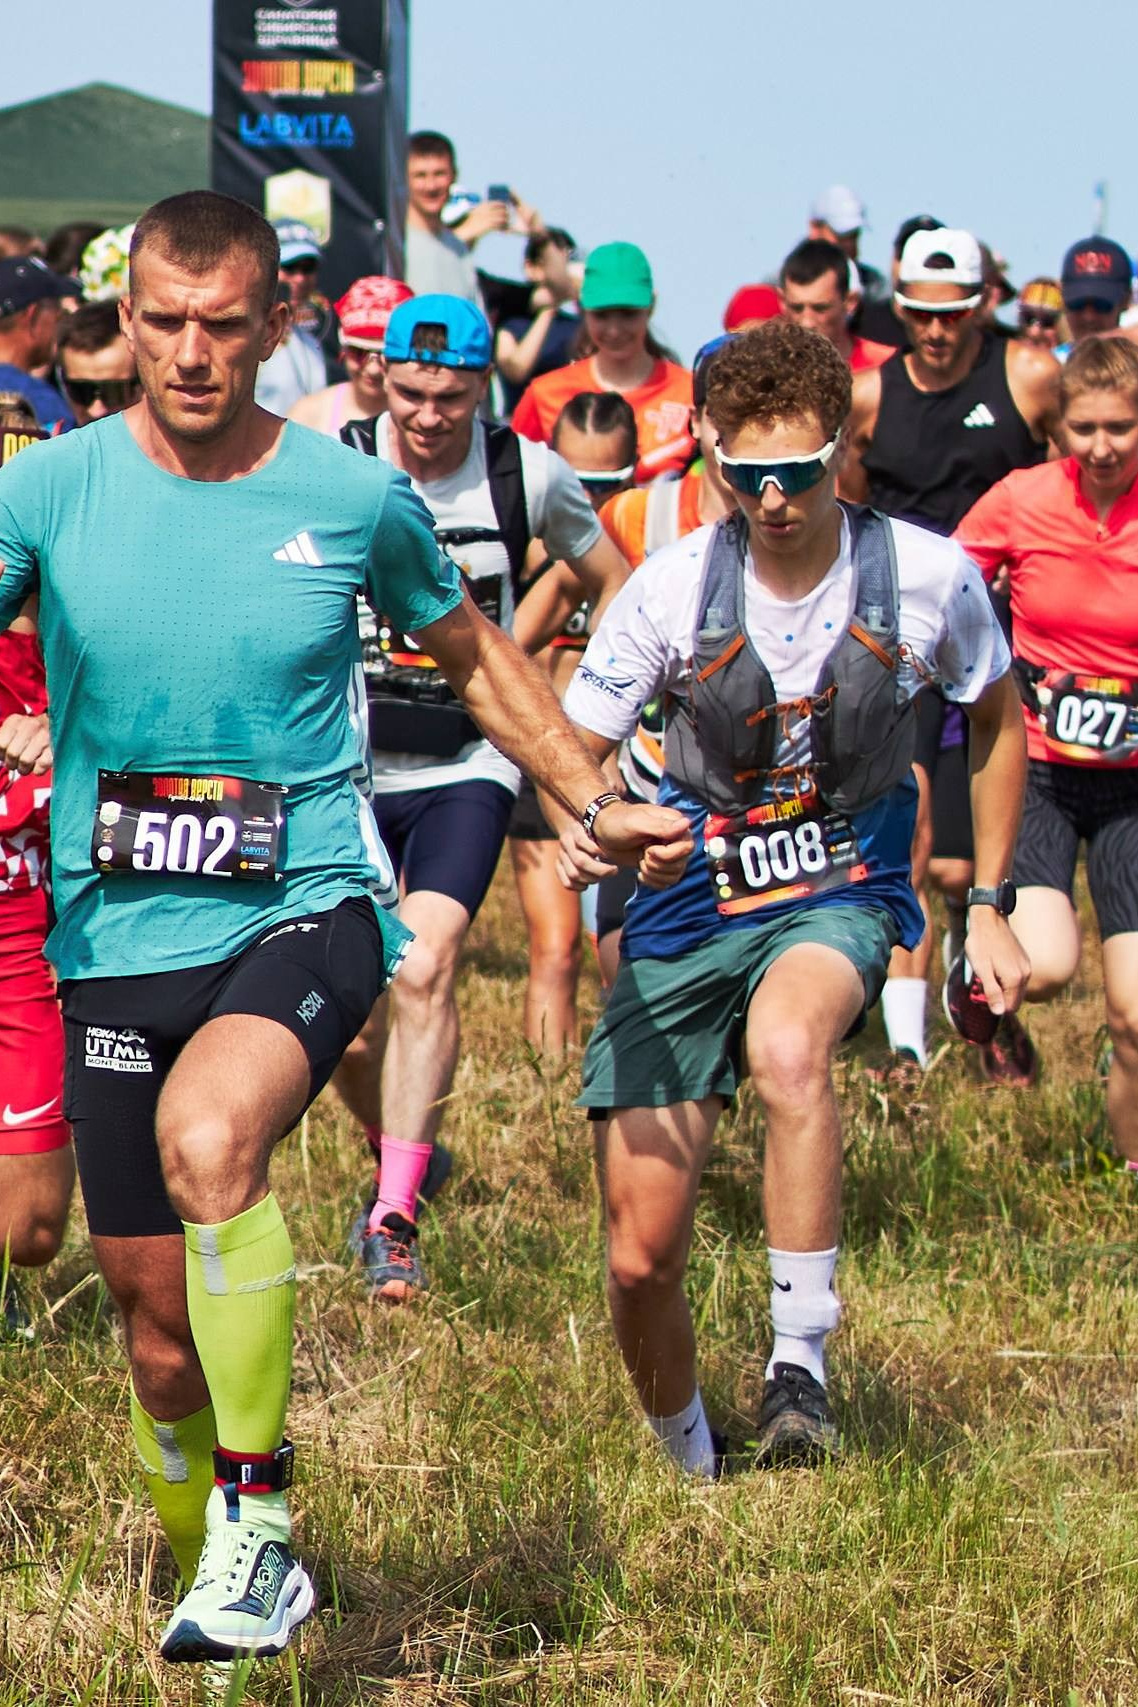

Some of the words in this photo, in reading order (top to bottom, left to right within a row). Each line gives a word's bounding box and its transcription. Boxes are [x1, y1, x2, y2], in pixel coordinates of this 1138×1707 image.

[240, 113, 353, 137] LABVITA
[1056, 695, 1127, 748] 027
[132, 811, 235, 877] 502
[740, 821, 825, 888] 008
[86, 1026, 116, 1041] HOKA
[296, 990, 325, 1025] HOKA
[249, 1543, 285, 1612] HOKA
